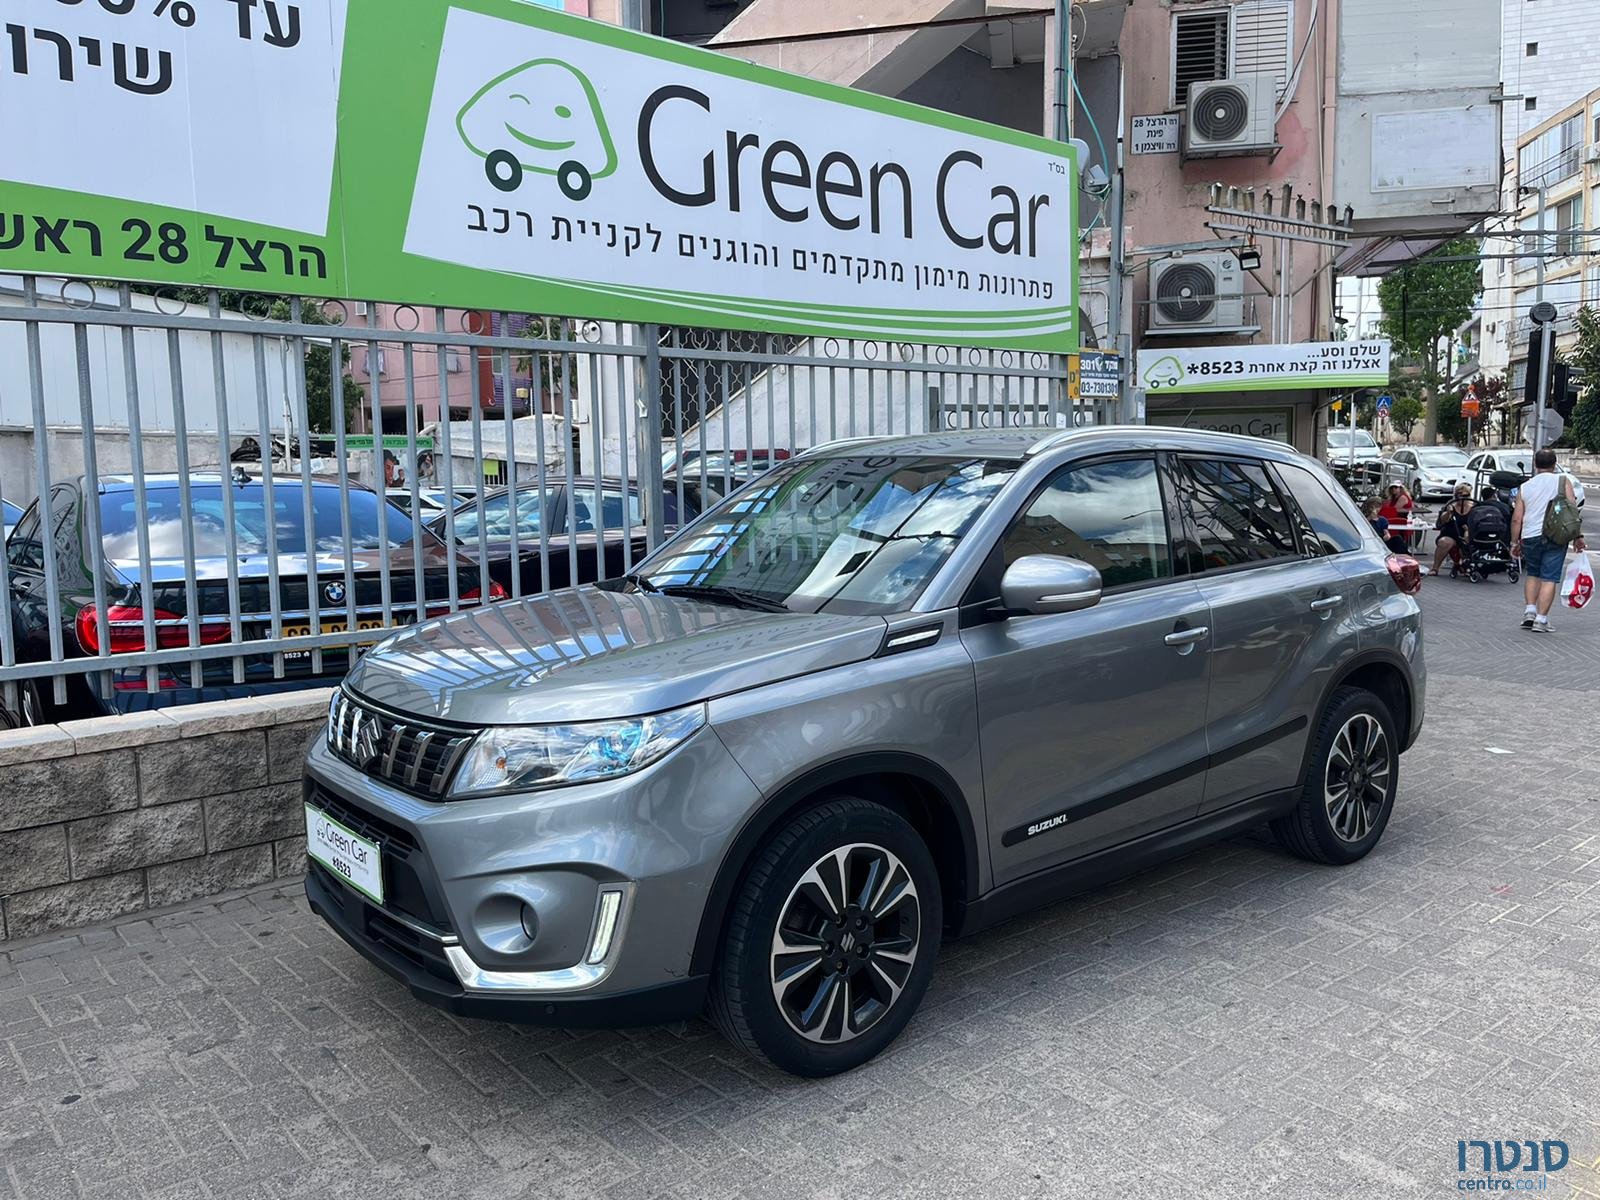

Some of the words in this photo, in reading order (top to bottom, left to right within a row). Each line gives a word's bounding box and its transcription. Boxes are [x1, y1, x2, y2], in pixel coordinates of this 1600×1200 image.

[1134, 119, 1144, 127] 28
[1146, 117, 1167, 126] הרצל
[1146, 129, 1163, 138] פינת
[1135, 143, 1139, 151] 1
[638, 84, 913, 240] Green
[936, 150, 1050, 258] Car
[467, 204, 533, 237] רכב
[121, 218, 189, 264] 28
[551, 215, 662, 257] לקניית
[204, 224, 327, 279] הרצל
[678, 233, 779, 268] והוגנים
[793, 249, 904, 285] מתקדמים
[914, 264, 969, 290] מימון
[978, 273, 1053, 300] פתרונות
[1350, 345, 1381, 356] שלם
[1248, 362, 1286, 374] אחרת
[1289, 361, 1318, 374] קצת
[1322, 360, 1338, 370] זה
[1341, 357, 1381, 370] אצלנו
[1247, 419, 1280, 437] Car
[1027, 813, 1067, 836] SUZUKI
[326, 822, 351, 855] Green
[351, 839, 368, 865] Car
